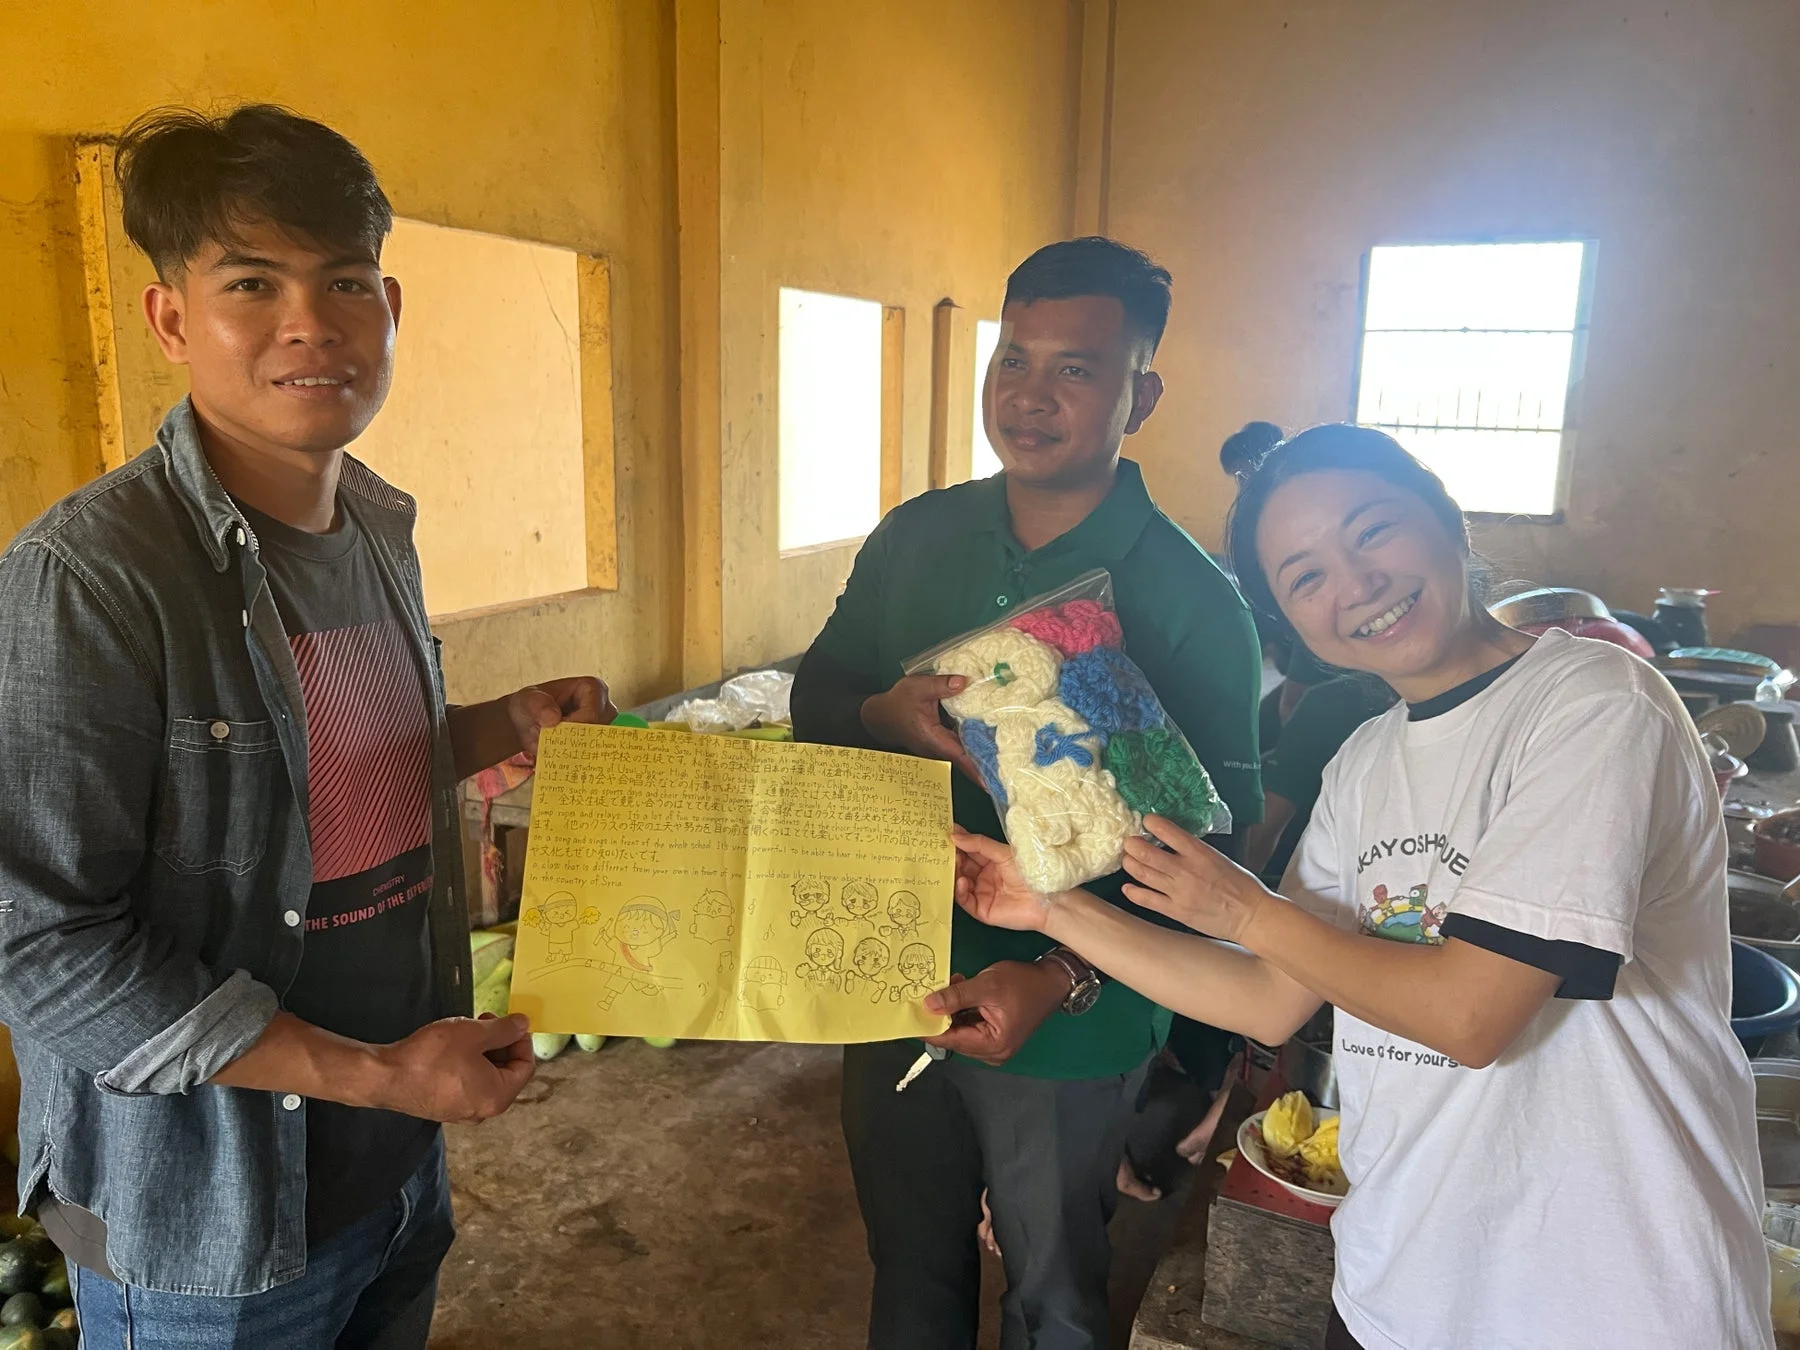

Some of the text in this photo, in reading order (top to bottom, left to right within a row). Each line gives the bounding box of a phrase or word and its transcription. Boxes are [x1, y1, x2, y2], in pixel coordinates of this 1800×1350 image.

[544, 760, 557, 770] We
[558, 763, 570, 771] are
[574, 763, 604, 773] students
[606, 762, 615, 773] of
[669, 767, 689, 778] High
[540, 785, 565, 793] events
[569, 786, 587, 795] such
[590, 788, 599, 796] as
[602, 788, 624, 797] sports
[645, 788, 659, 798] and
[839, 803, 851, 812] the
[579, 809, 594, 819] and
[651, 809, 662, 821] lot
[665, 810, 675, 821] of
[676, 810, 689, 821] fun
[817, 821, 830, 831] the
[533, 834, 544, 842] on
[554, 836, 571, 846] song
[572, 835, 587, 845] and
[610, 837, 618, 846] in
[620, 835, 641, 847] front
[641, 837, 651, 848] of
[668, 839, 689, 850] whole
[731, 844, 749, 854] very
[789, 847, 799, 856] to
[801, 845, 810, 857] be
[810, 847, 826, 858] able
[855, 850, 868, 861] the
[903, 854, 917, 864] and
[529, 872, 538, 882] in
[541, 871, 554, 882] the
[555, 875, 588, 888] country
[589, 874, 600, 886] of
[541, 858, 561, 868] class
[563, 859, 581, 871] that
[582, 863, 590, 871] is
[592, 859, 629, 873] different
[632, 862, 651, 874] from
[672, 868, 690, 876] own
[792, 868, 807, 880] like
[303, 917, 329, 931] THE
[332, 906, 376, 928] SOUND
[377, 900, 386, 914] OF
[386, 892, 406, 909] THE
[1341, 1038, 1376, 1057] Love
[1387, 1045, 1412, 1062] for
[1414, 1051, 1465, 1069] yours
